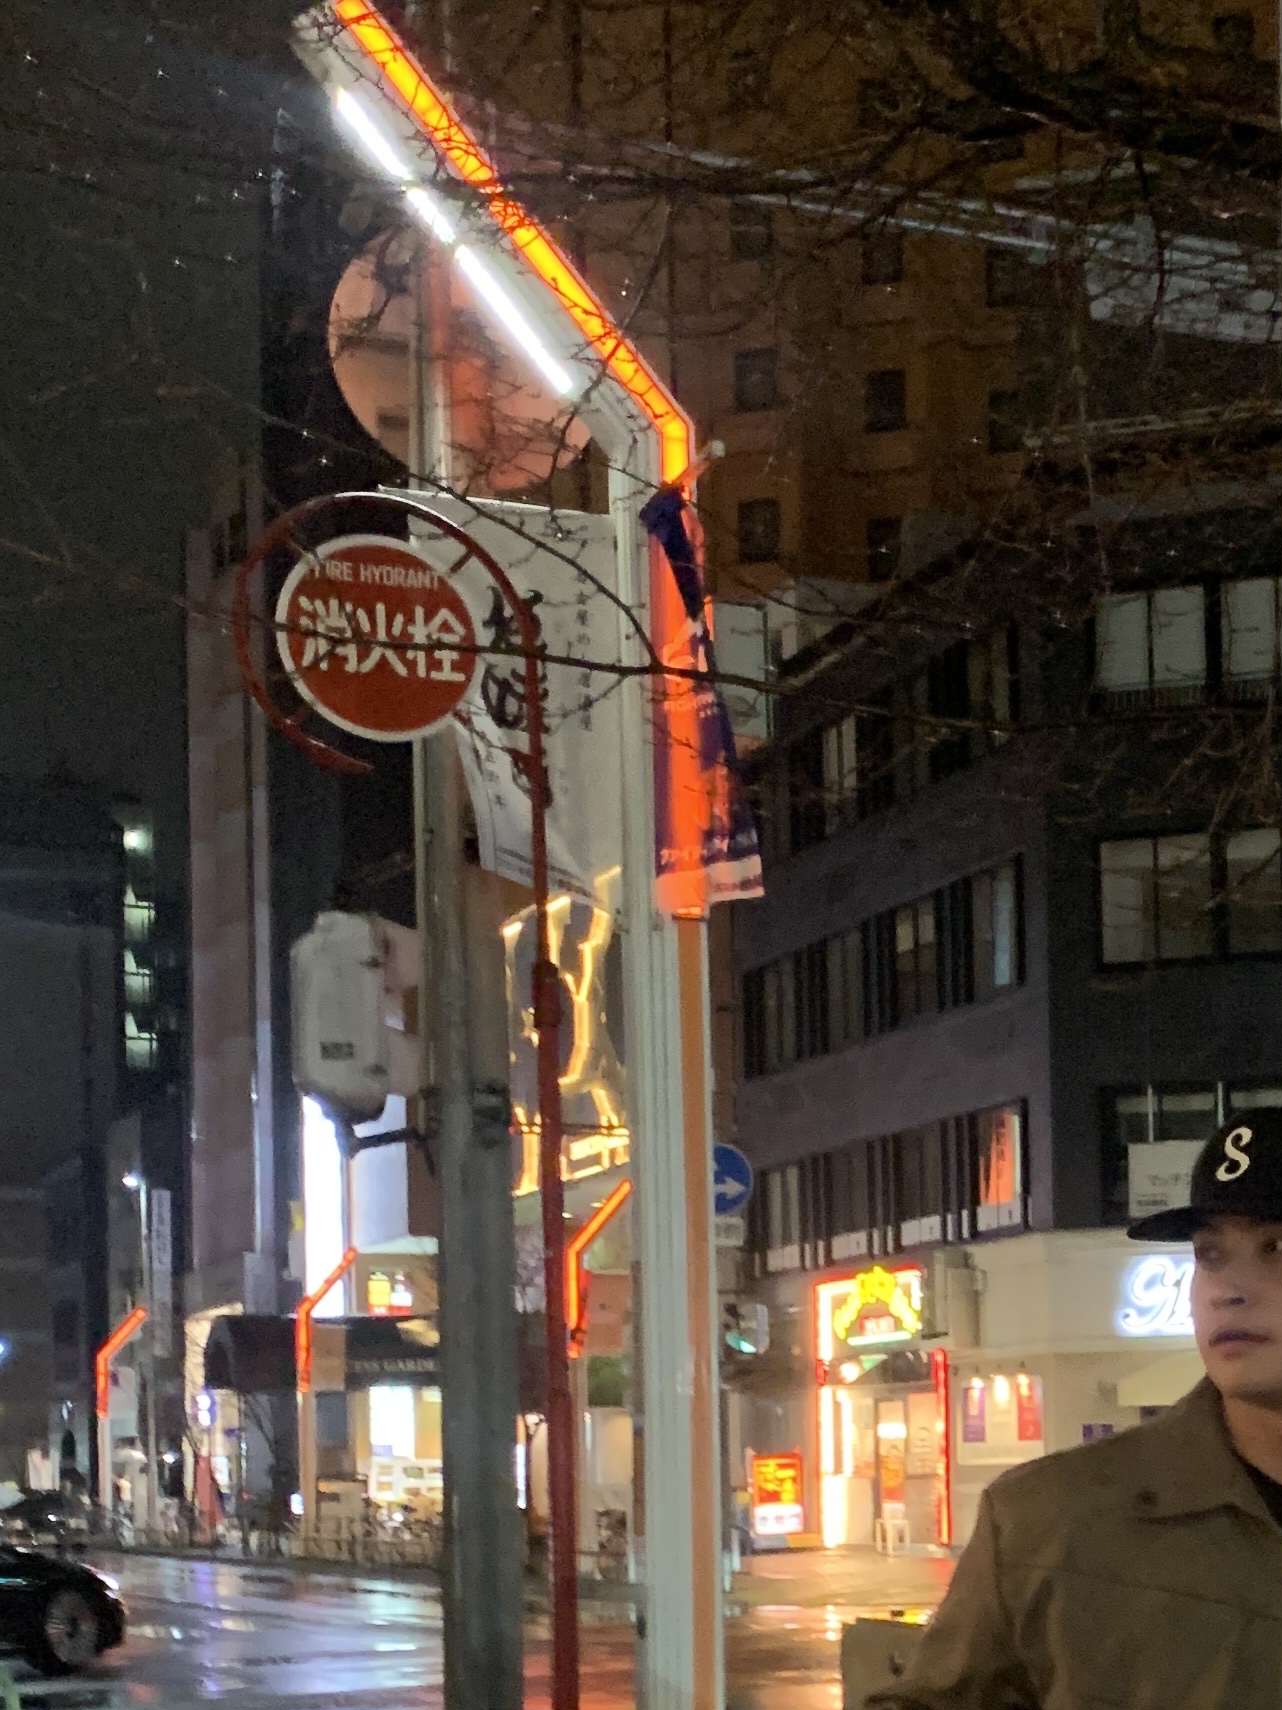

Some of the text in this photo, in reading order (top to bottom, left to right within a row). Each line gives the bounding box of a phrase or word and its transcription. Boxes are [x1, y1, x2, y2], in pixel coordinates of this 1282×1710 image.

[360, 562, 439, 590] HYDRANT
[299, 595, 466, 682] 消火栓
[1215, 1126, 1252, 1182] S
